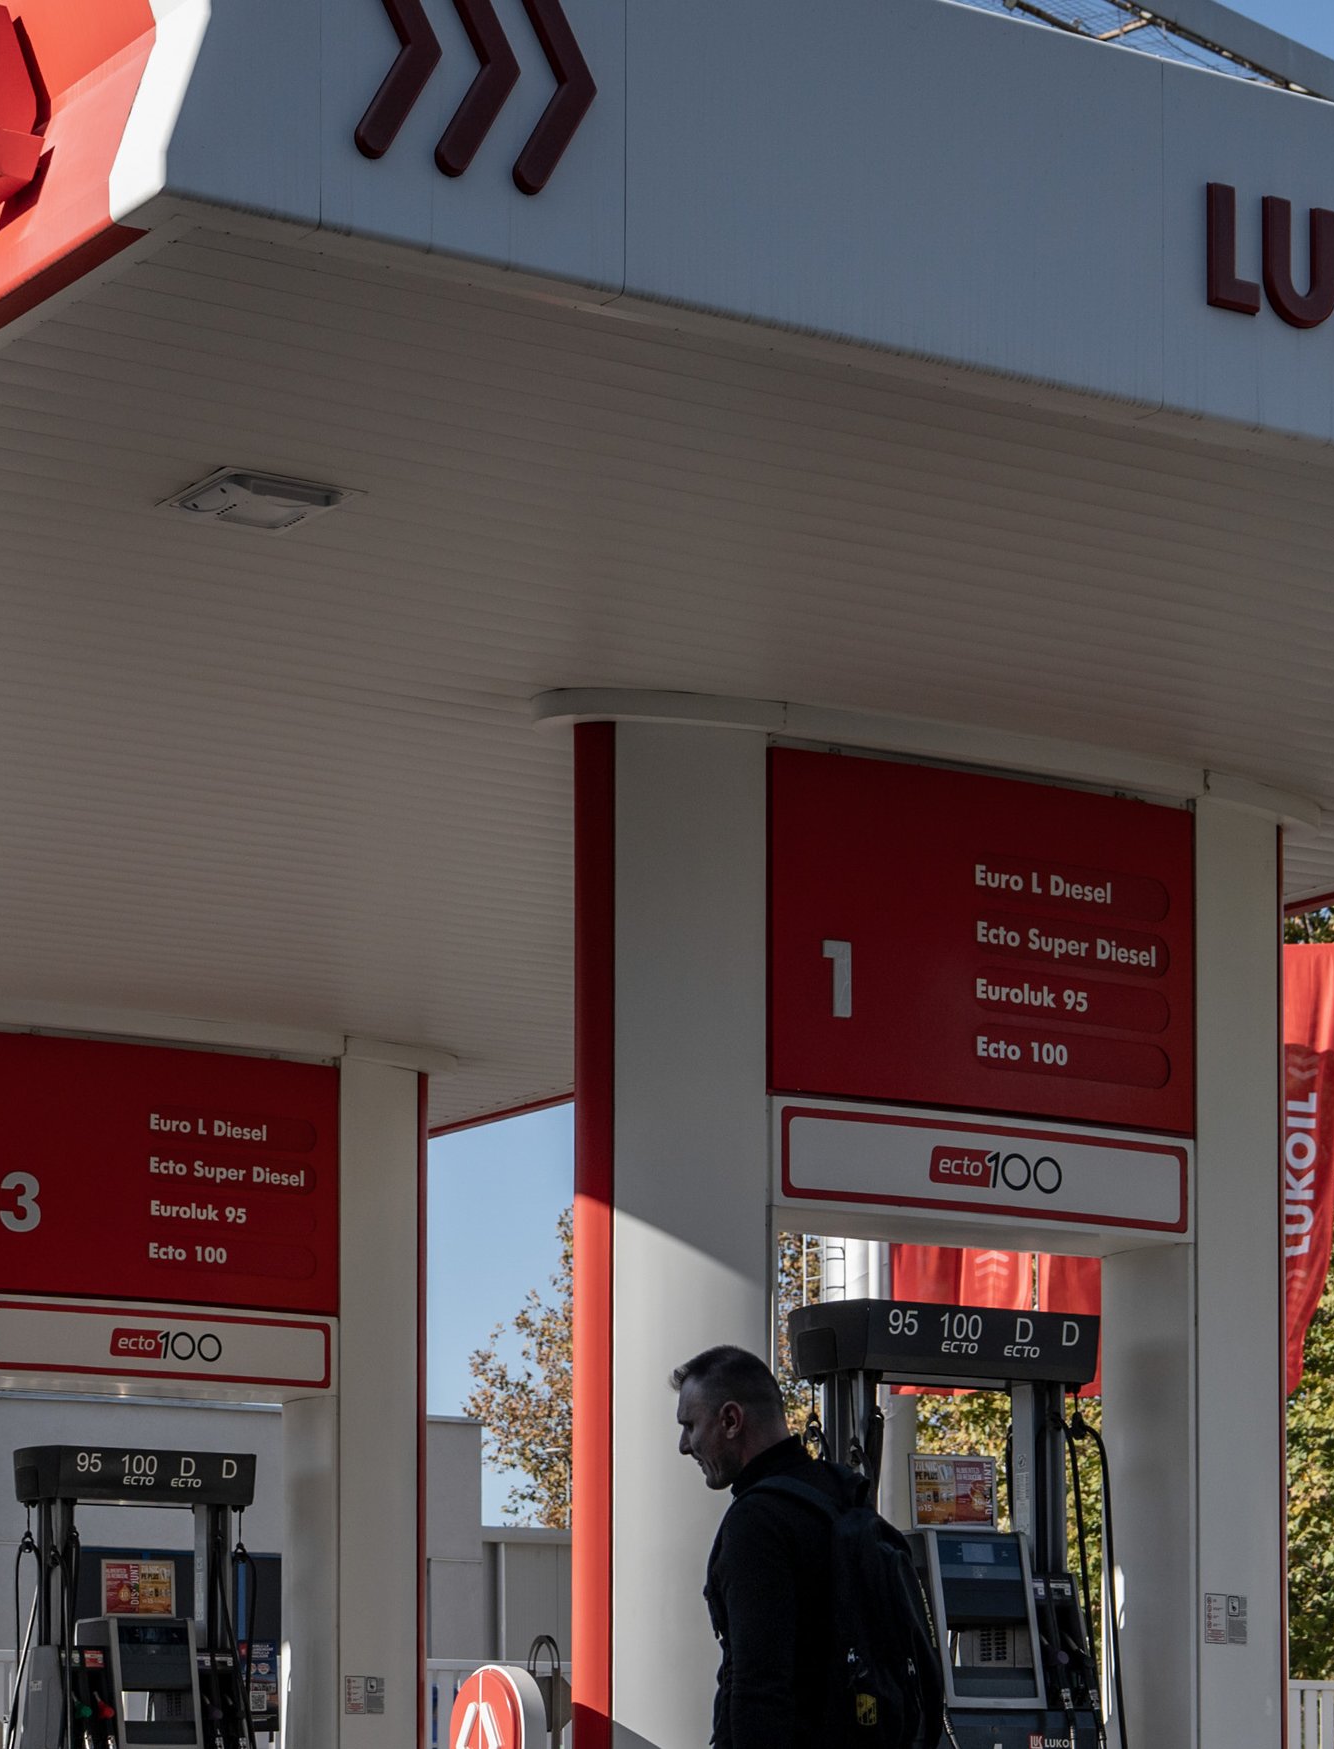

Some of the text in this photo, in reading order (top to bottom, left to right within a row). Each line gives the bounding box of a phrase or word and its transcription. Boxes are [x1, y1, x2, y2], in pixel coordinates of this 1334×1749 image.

[974, 864, 1112, 904] Euro L Diesel
[976, 920, 1156, 968] Ecto Super Diesel
[822, 939, 852, 1018] 1
[975, 978, 1088, 1013] Euroluk 95
[976, 1035, 1067, 1066] Ecto 100
[149, 1113, 267, 1142] Euro L Diesel
[149, 1156, 305, 1187] Ecto Super Diesel
[1285, 1092, 1317, 1258] LUKOIL
[0, 1171, 41, 1233] 3
[150, 1200, 247, 1224] Euroluk 95
[148, 1243, 227, 1264] Ecto 100
[888, 1309, 1080, 1347] 95 100 D D
[941, 1341, 1040, 1358] ECTO ECTO
[76, 1452, 238, 1479] 95 100 D D
[122, 1475, 202, 1489] ECTO ECTO
